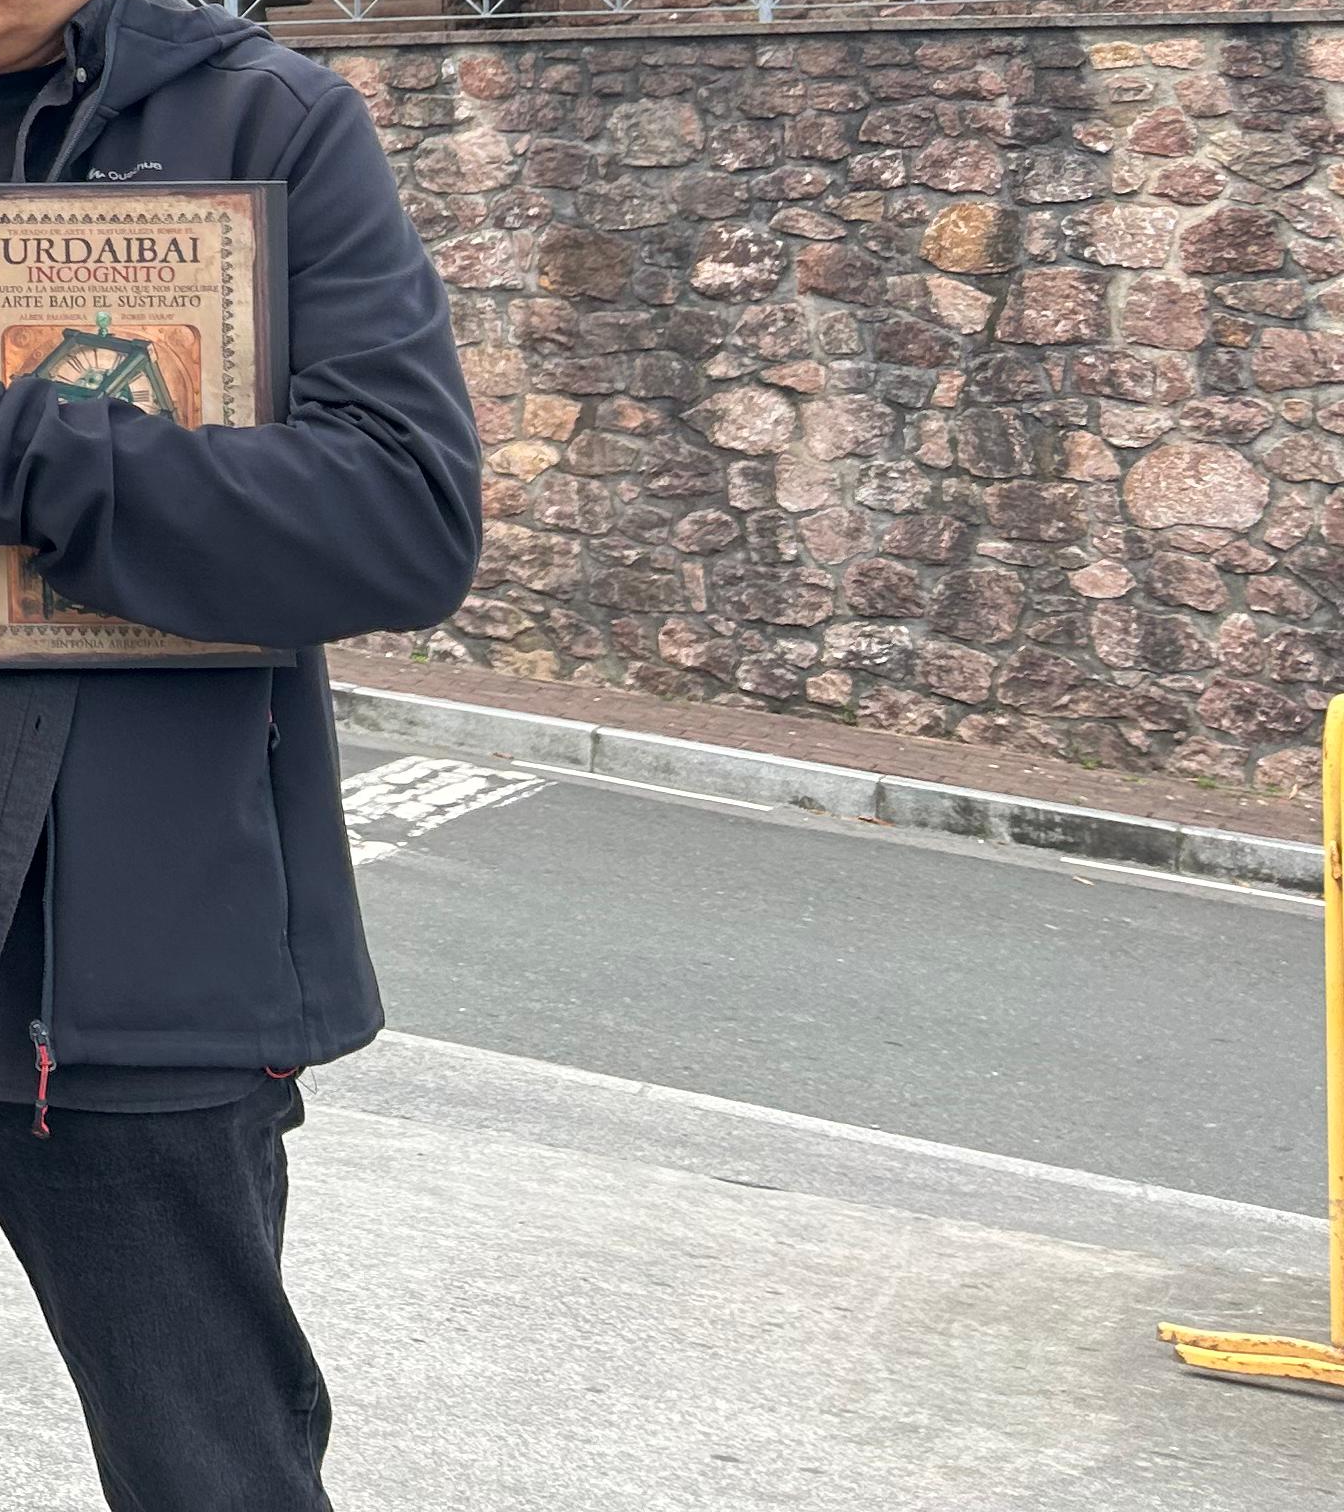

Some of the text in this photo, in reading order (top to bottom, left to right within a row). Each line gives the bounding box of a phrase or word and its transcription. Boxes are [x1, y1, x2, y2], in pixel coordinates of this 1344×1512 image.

[0, 237, 201, 265] URDAIBAI
[26, 266, 176, 284] INCOGNITO
[1, 295, 201, 309] ARTE BAJO EL SUSTRATO
